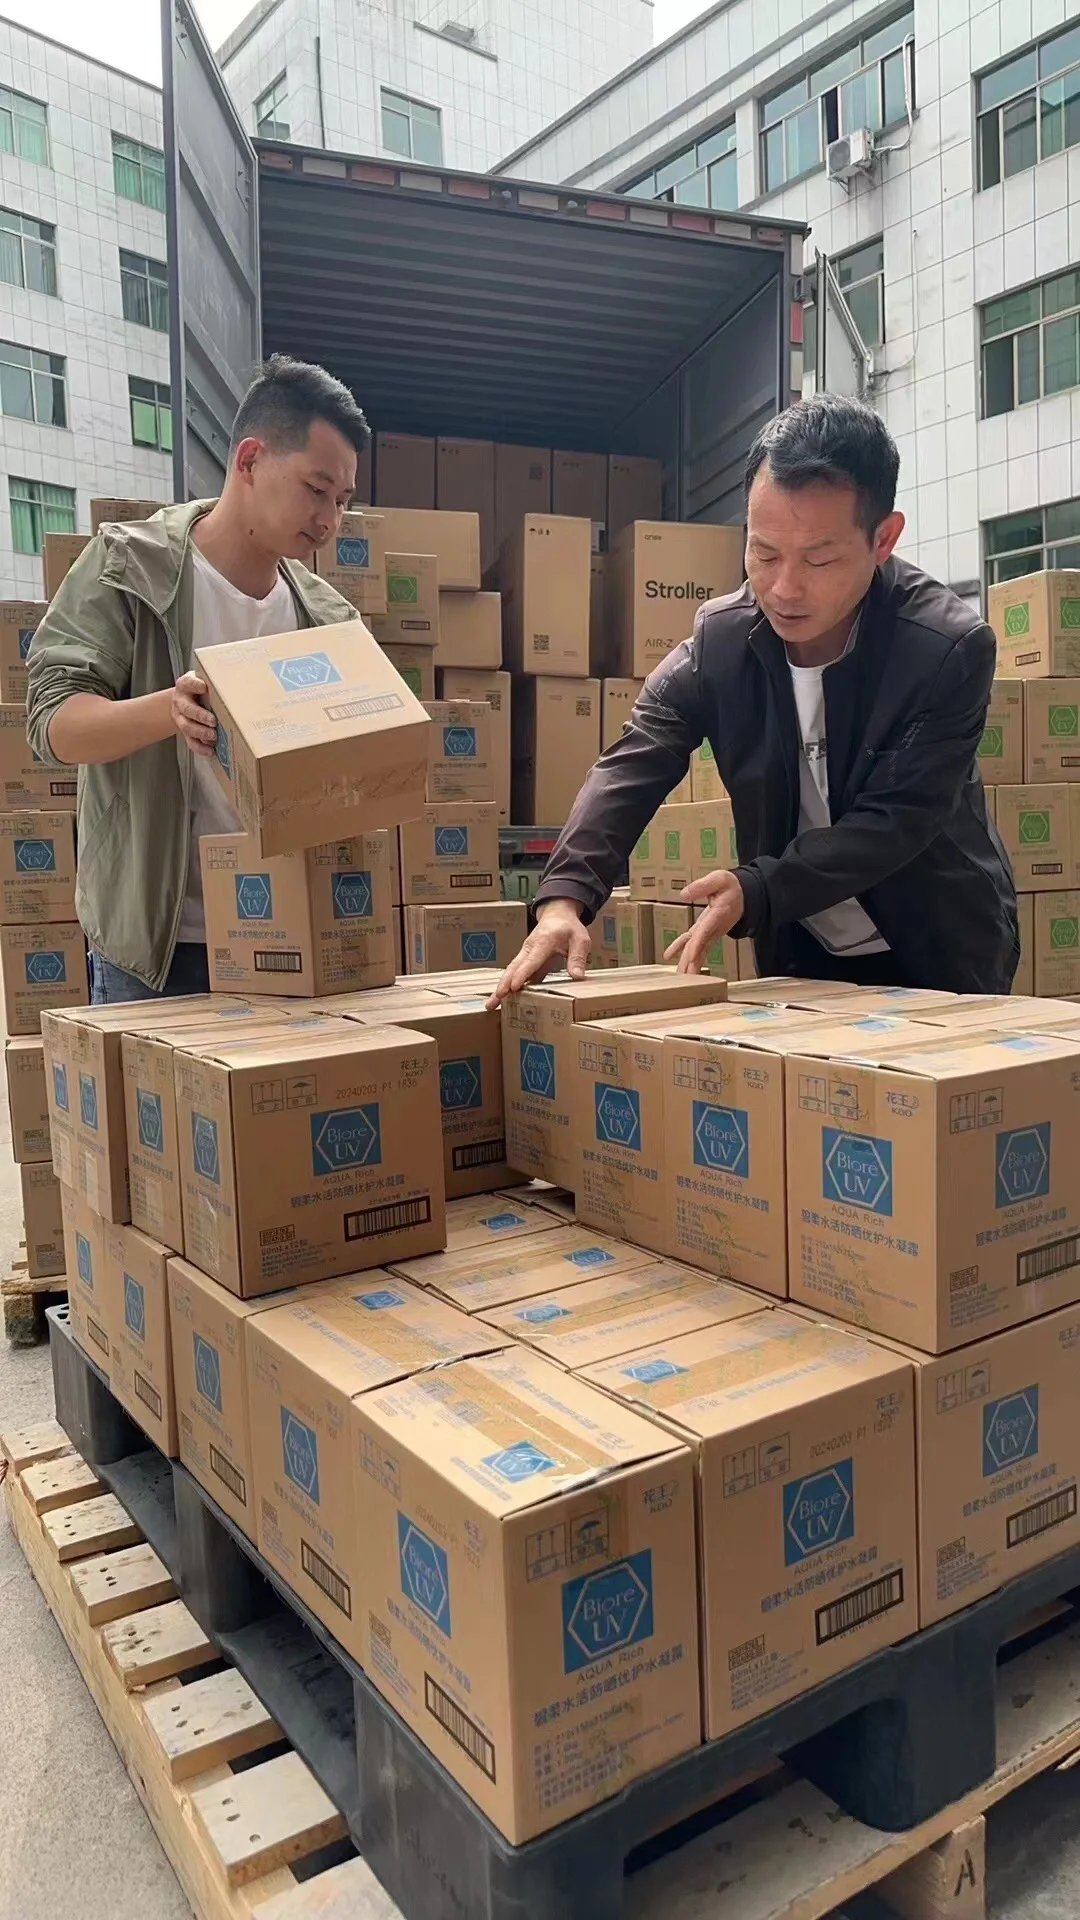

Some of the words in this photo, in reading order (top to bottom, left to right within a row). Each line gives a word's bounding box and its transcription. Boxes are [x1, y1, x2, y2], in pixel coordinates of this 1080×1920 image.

[645, 580, 714, 600] Stroller
[645, 638, 673, 649] AIR-Z
[247, 899, 261, 912] UV
[345, 897, 360, 910] UV
[530, 1071, 546, 1087] UV
[335, 1085, 378, 1100] 20240203
[445, 1087, 465, 1103] UV
[609, 1119, 628, 1136] UV
[335, 1139, 362, 1160] UV
[710, 1141, 733, 1161] UV
[322, 1173, 351, 1186] AQUA
[354, 1168, 376, 1180] Rich
[700, 1168, 723, 1183] AQUA
[726, 1174, 743, 1189] Rich
[844, 1172, 872, 1197] UV
[1013, 1166, 1036, 1189] UV
[832, 1204, 860, 1220] AQUA
[863, 1213, 885, 1228] Rich
[809, 1431, 852, 1459] 20240203
[1000, 1428, 1023, 1456] UV
[806, 1510, 834, 1541] UV
[793, 1557, 823, 1577] AQUA
[827, 1544, 848, 1561] Rich
[415, 1568, 436, 1604] UV
[593, 1608, 628, 1642] UV
[576, 1661, 613, 1685] AQUA
[618, 1646, 645, 1666] Rich
[953, 1847, 977, 1897] A
